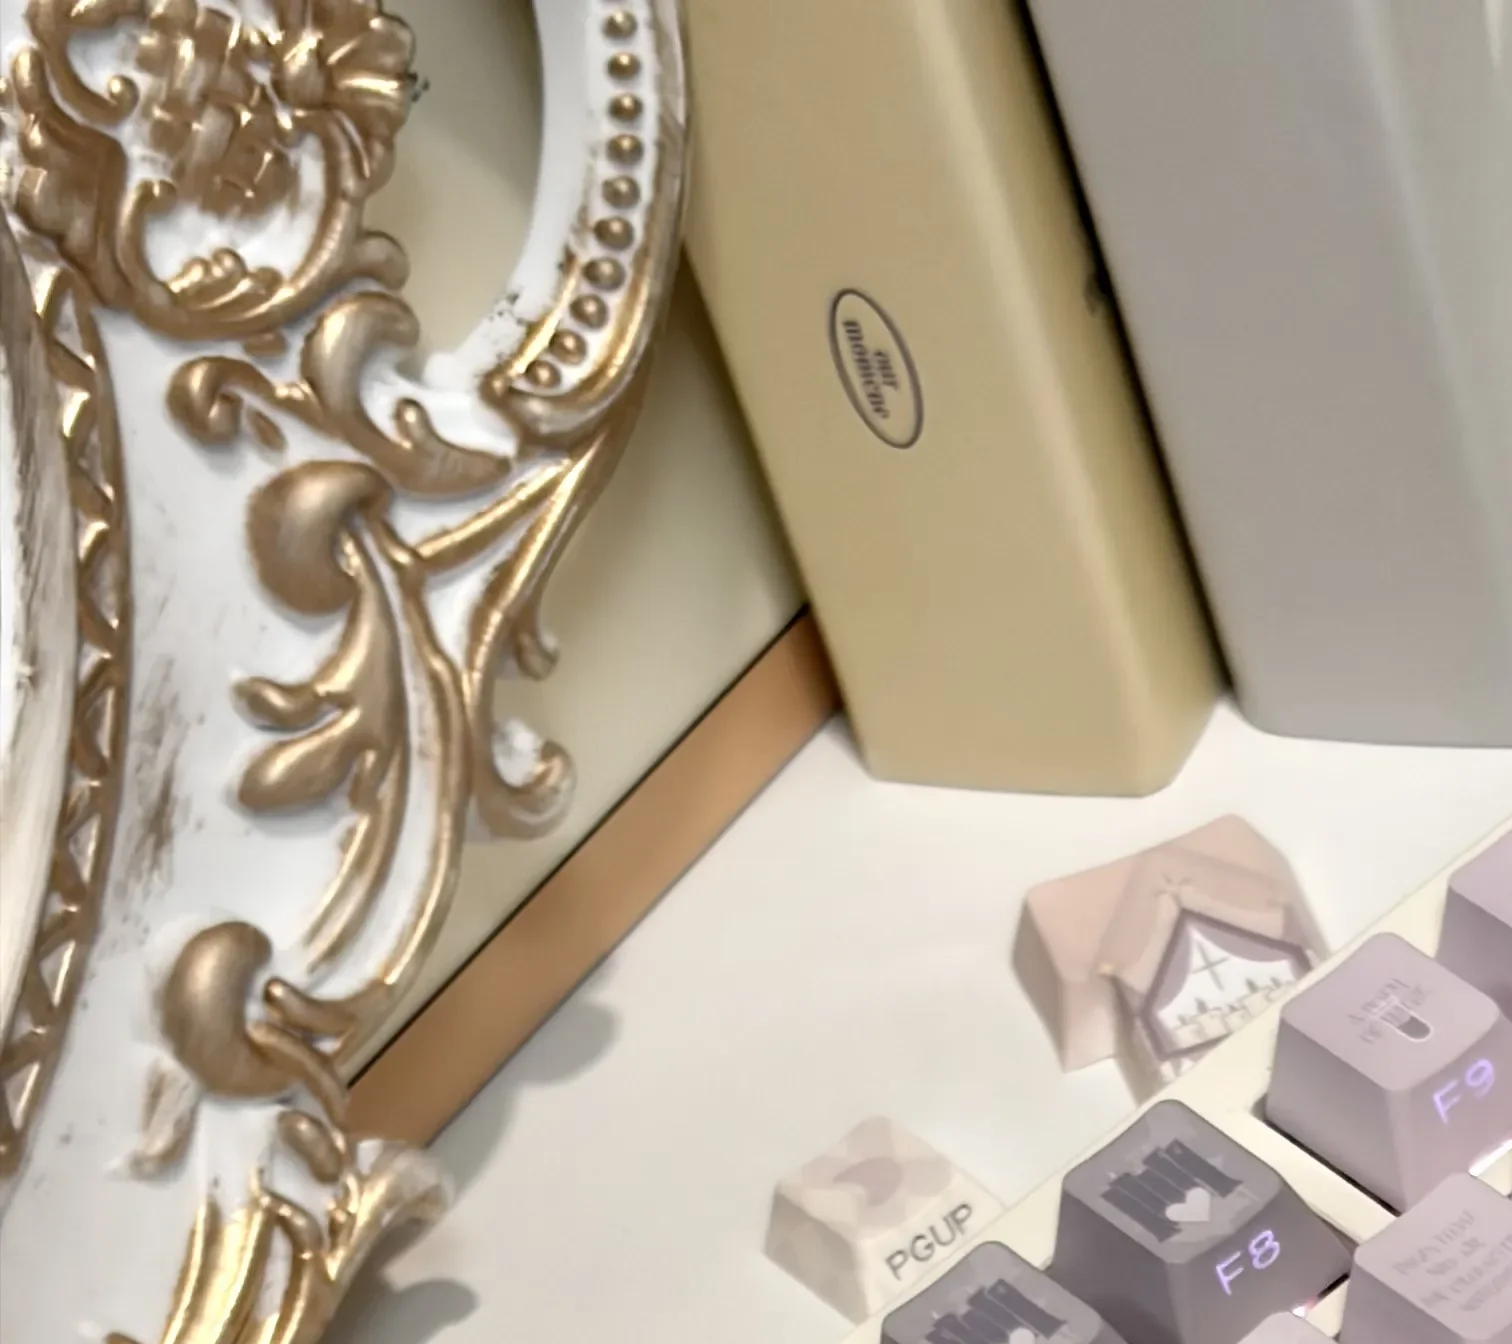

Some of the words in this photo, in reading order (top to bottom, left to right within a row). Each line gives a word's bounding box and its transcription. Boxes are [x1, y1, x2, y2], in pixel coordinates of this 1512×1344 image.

[1431, 1058, 1496, 1124] F9
[885, 1203, 974, 1281] PGUP
[1213, 1229, 1281, 1296] F8
